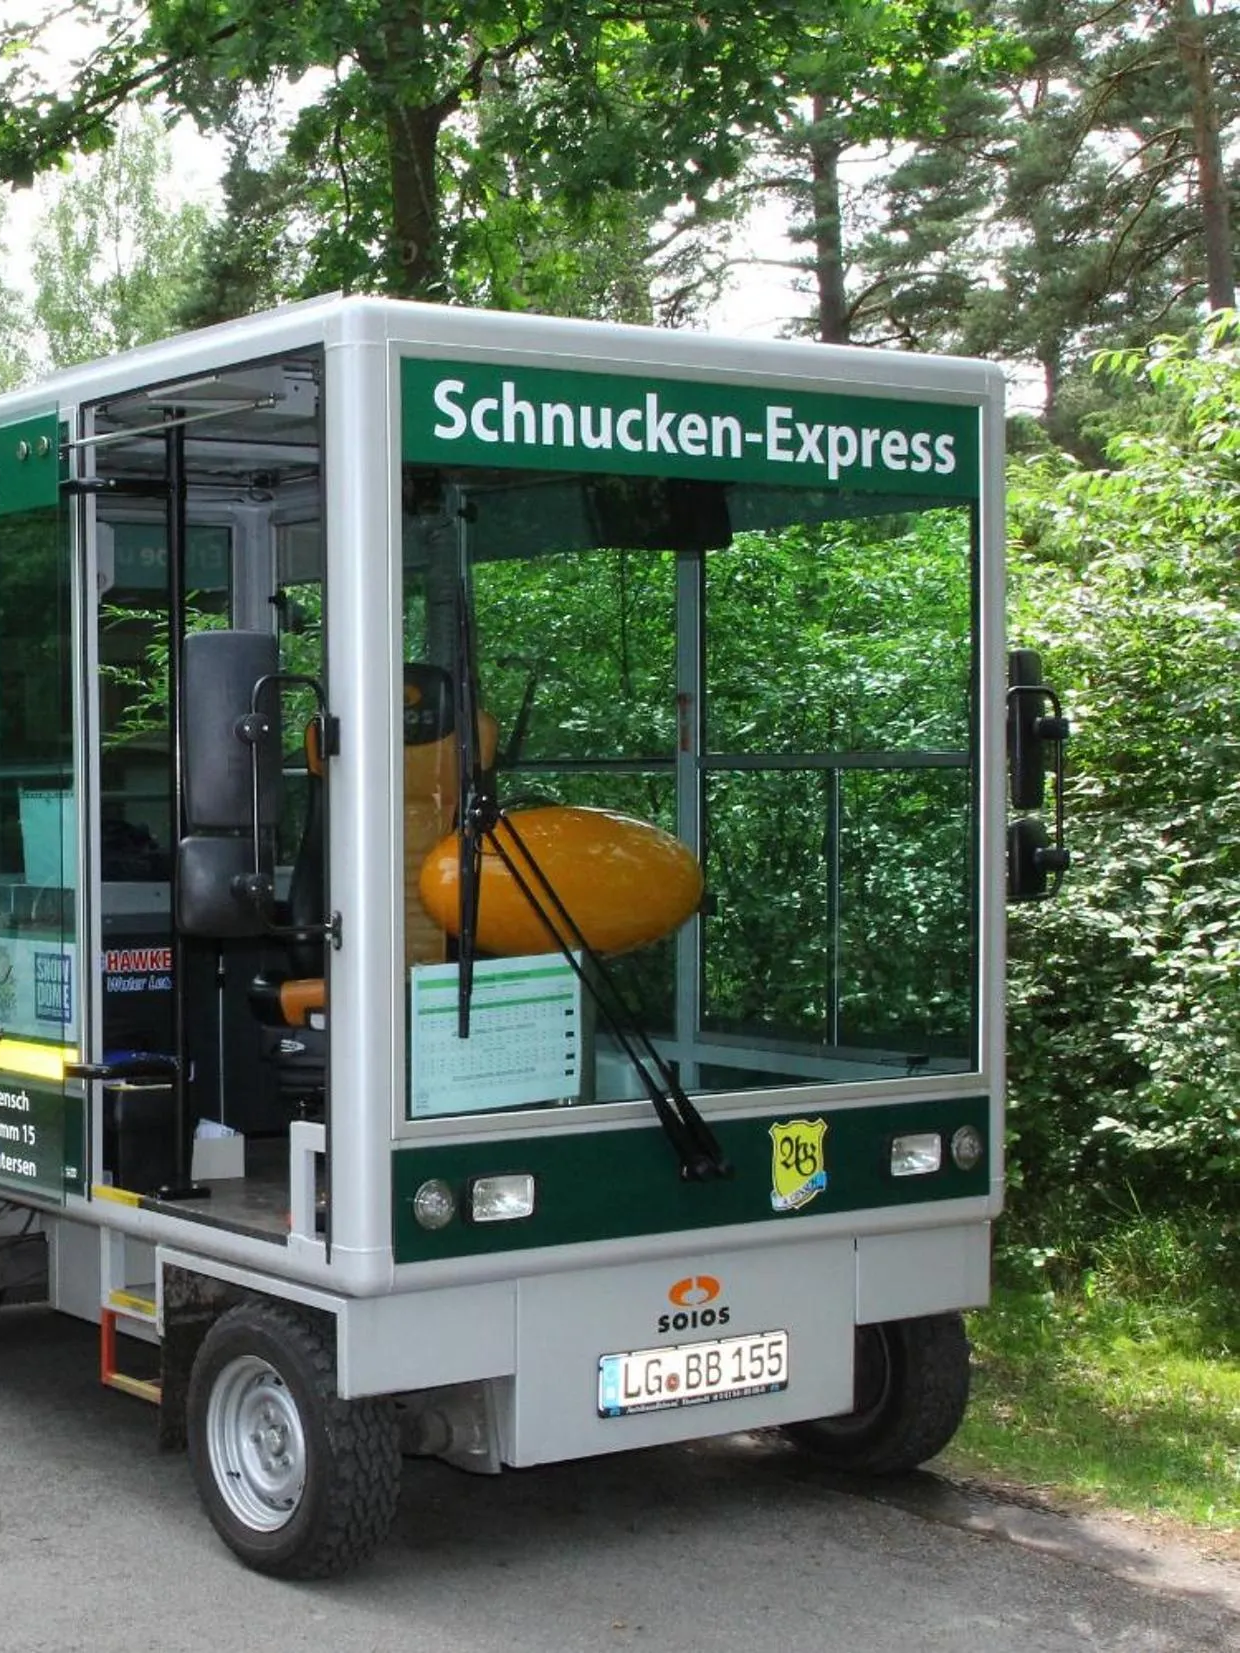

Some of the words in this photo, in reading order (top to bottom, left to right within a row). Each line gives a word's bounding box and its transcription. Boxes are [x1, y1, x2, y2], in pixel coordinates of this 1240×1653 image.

[433, 379, 956, 480] Schnucken-Express
[22, 1124, 36, 1146] 15
[624, 1358, 663, 1399] LG
[685, 1350, 722, 1390] BB
[731, 1340, 783, 1383] 155
